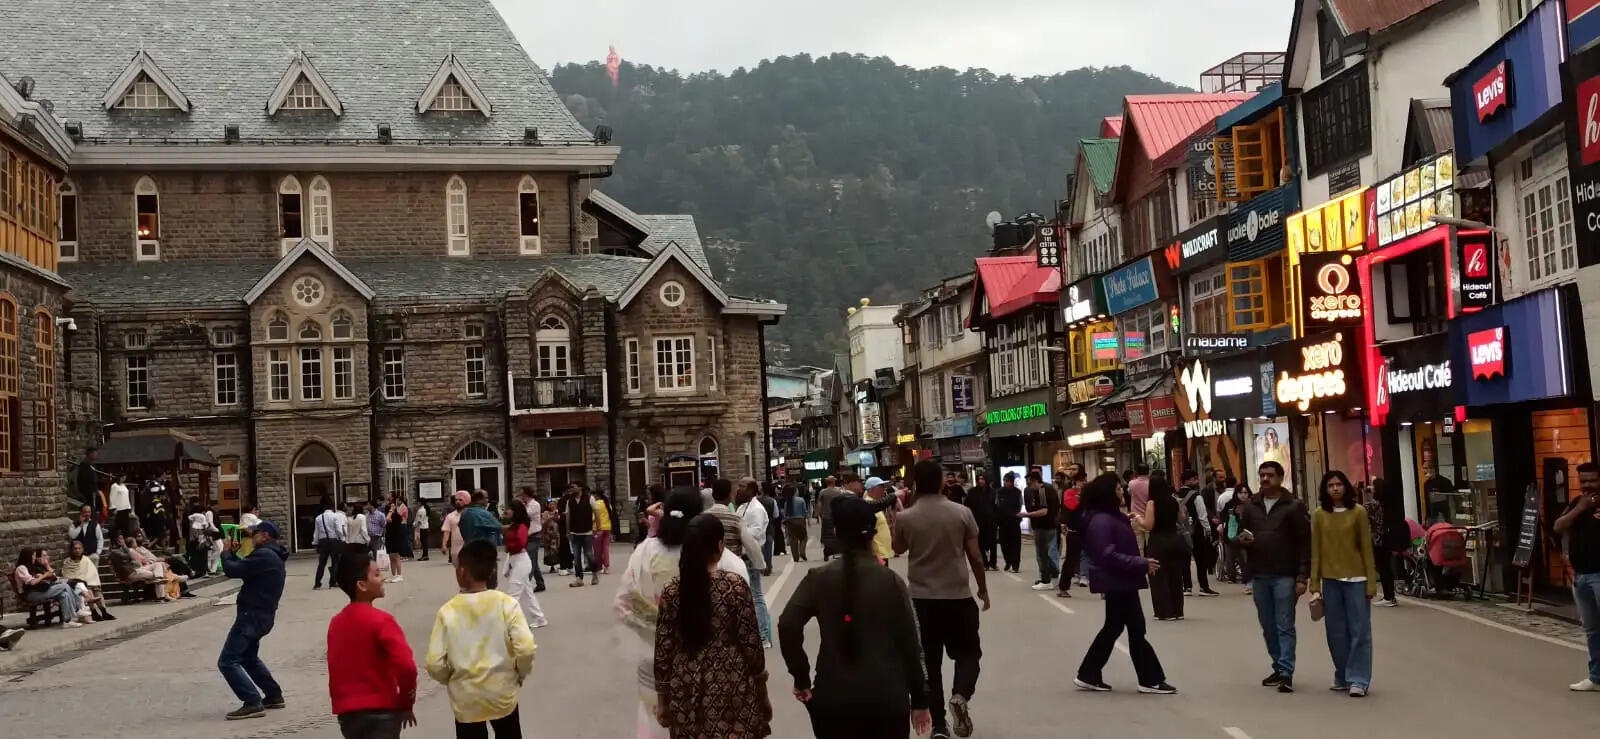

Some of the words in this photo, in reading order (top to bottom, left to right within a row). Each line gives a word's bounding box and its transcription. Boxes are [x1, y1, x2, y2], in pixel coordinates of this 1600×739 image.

[1258, 208, 1279, 231] bake
[1182, 228, 1218, 259] WILDCRAFT
[1462, 282, 1492, 291] Hideout
[1310, 295, 1361, 310] xero
[1311, 308, 1361, 321] degrees
[1302, 341, 1342, 371] xero
[1387, 367, 1424, 394] Hideout
[1424, 360, 1452, 389] Café
[1277, 370, 1346, 411] degrees
[1152, 407, 1176, 418] SHREE
